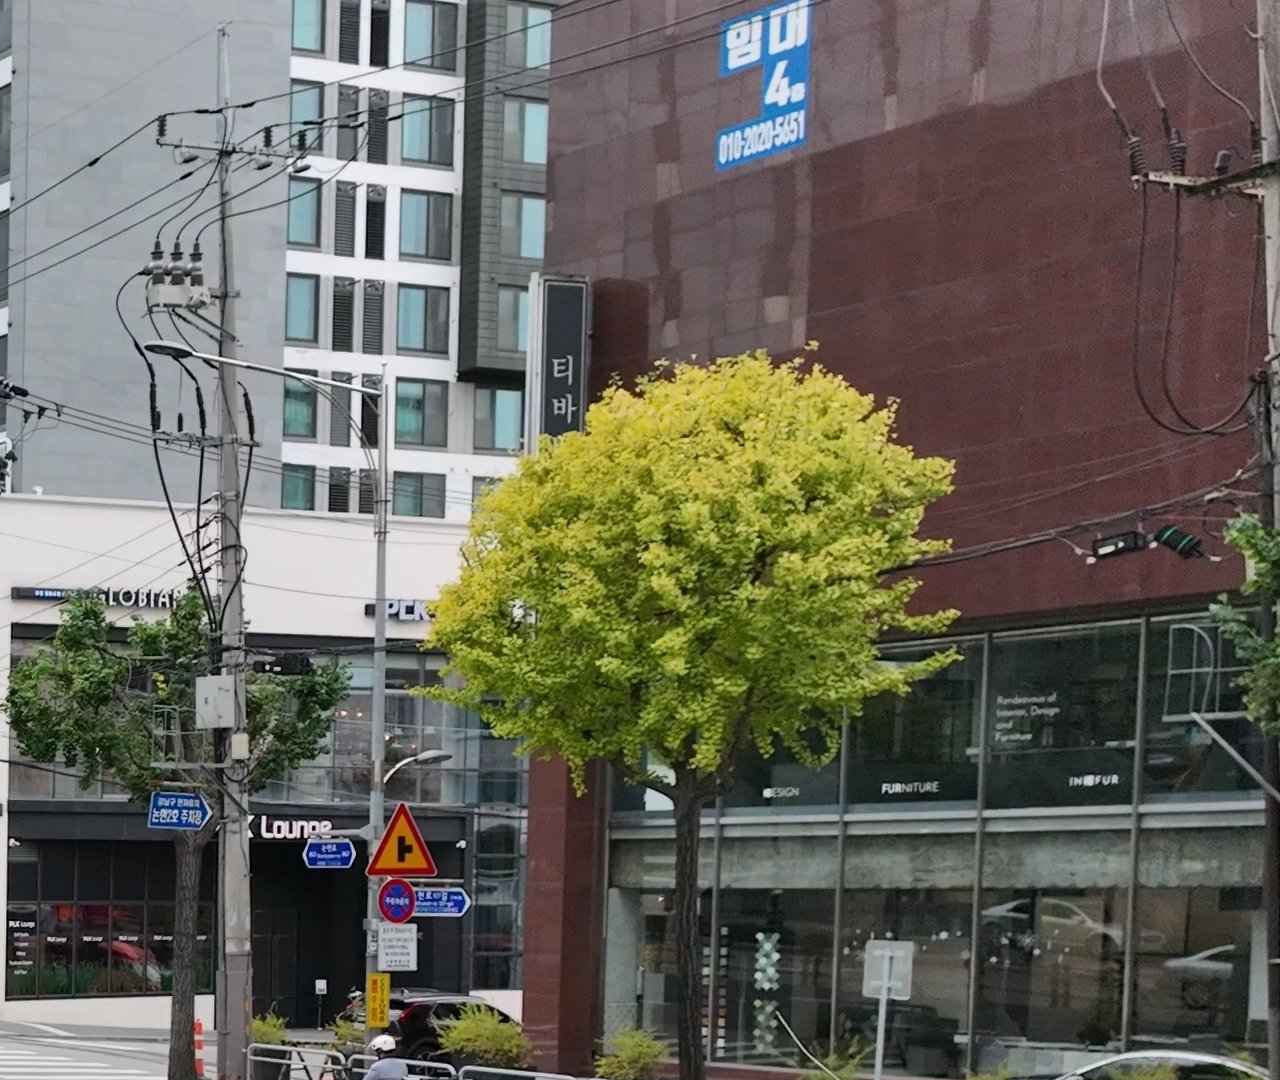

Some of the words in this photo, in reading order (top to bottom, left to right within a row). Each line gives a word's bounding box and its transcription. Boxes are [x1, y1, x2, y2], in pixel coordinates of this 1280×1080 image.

[726, 0, 809, 70] 임대
[719, 110, 805, 164] 010-2020-5651
[881, 781, 940, 794] FURNITURE
